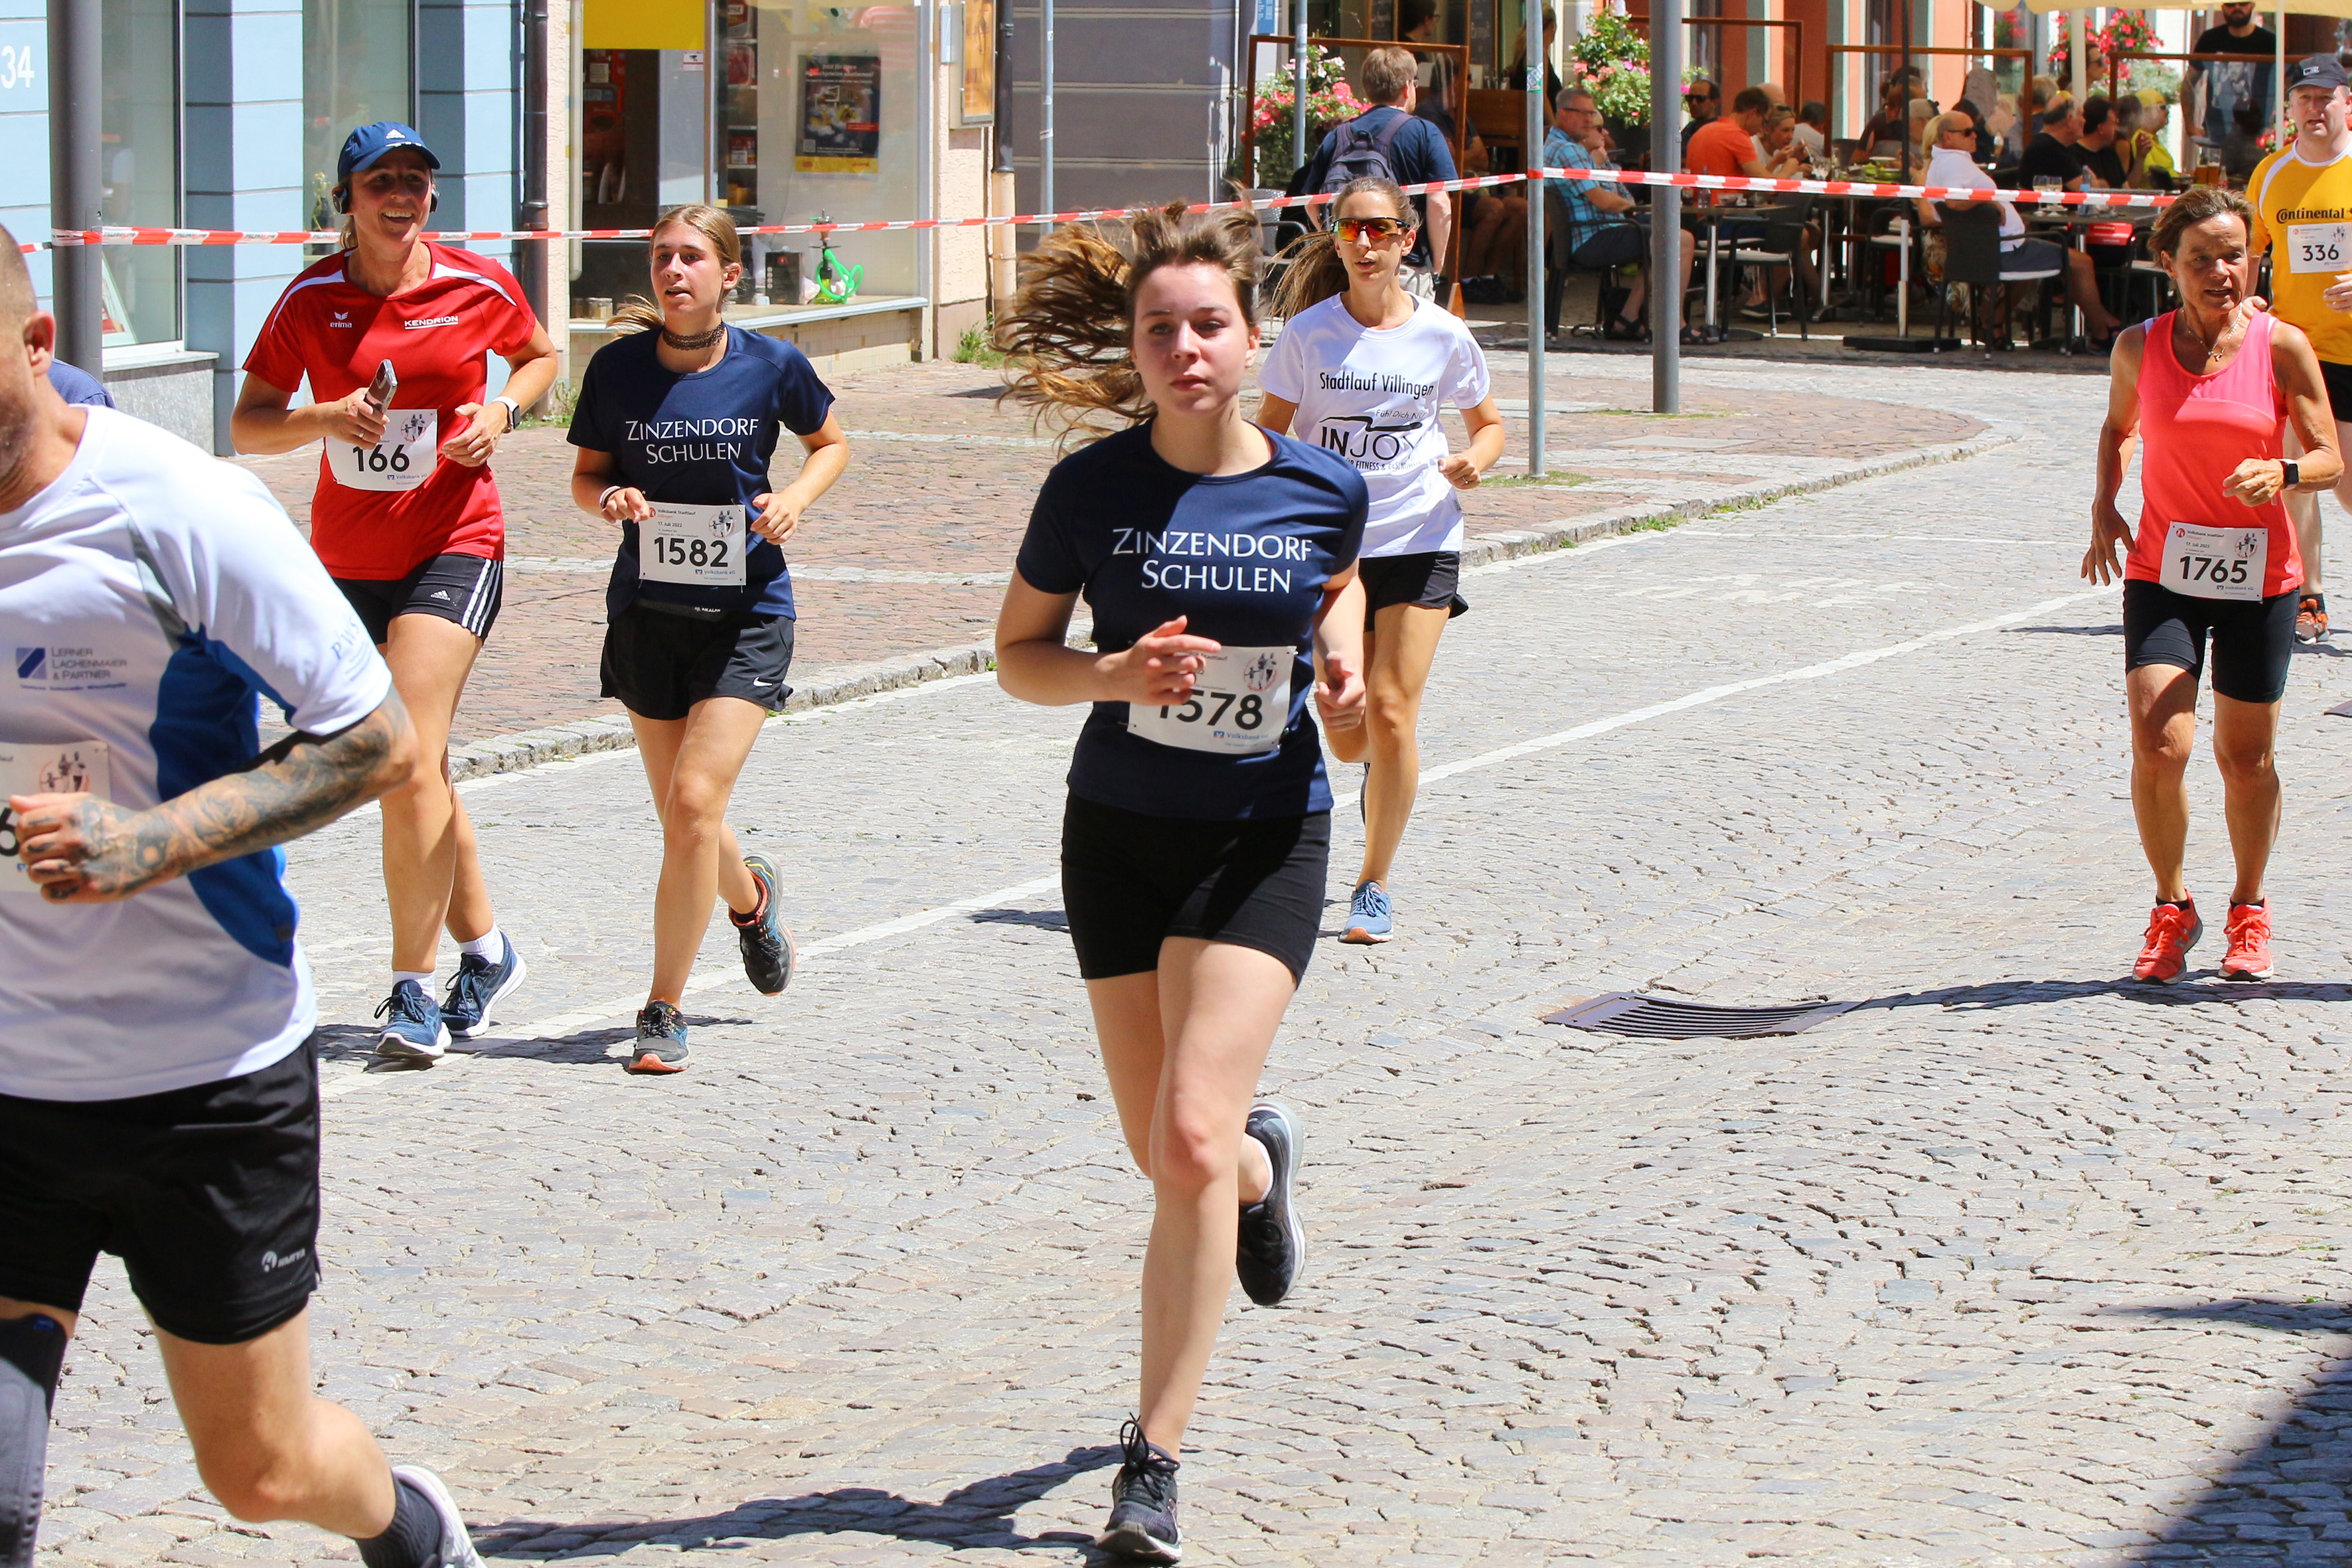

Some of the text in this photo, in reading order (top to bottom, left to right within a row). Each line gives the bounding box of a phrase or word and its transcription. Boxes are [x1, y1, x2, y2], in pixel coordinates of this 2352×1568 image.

[1, 44, 35, 89] 34
[2276, 208, 2344, 224] Continental
[2302, 244, 2339, 262] 336
[404, 315, 459, 327] KENDRION
[1320, 372, 1434, 400] Stadtlauf Villingen
[625, 418, 759, 441] ZINZENDORF
[353, 444, 410, 472] 166
[646, 443, 742, 464] SCHULEN
[1356, 461, 1379, 471] FITNESS
[655, 536, 728, 568] 1582
[1113, 528, 1312, 562] ZINZENDORF
[1141, 560, 1291, 593] SCHULEN
[2180, 556, 2248, 584] 1765
[51, 647, 93, 657] LERNER
[62, 670, 111, 680] PARTNER
